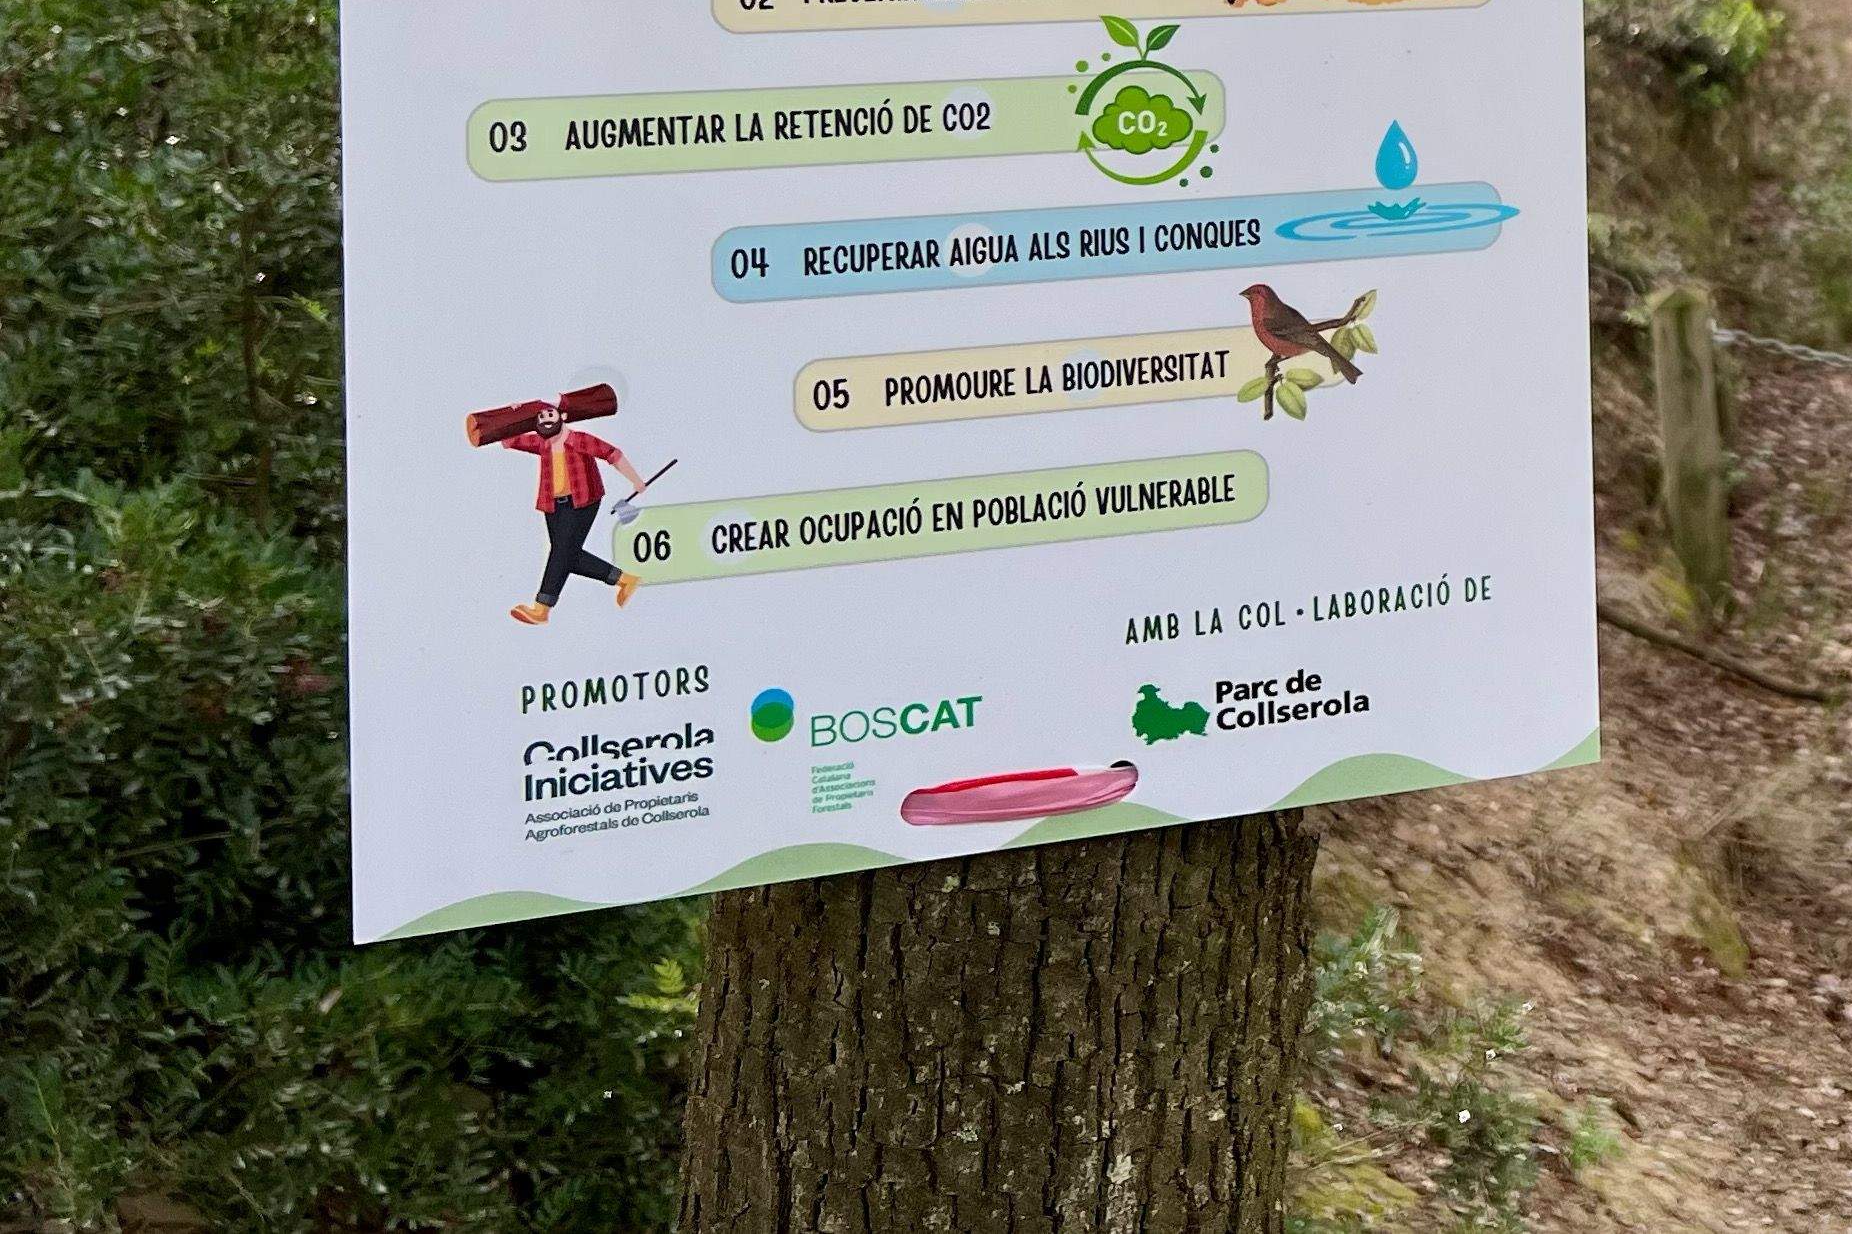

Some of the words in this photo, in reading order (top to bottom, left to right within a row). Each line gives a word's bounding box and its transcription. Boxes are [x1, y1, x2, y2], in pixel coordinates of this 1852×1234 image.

[488, 120, 528, 153] 03
[564, 113, 726, 151] AUGMENTAR
[735, 111, 764, 143] LA
[773, 98, 894, 142] RETENCIÓ
[903, 105, 933, 136] DE
[942, 102, 991, 133] CO2
[730, 246, 770, 279] 04
[803, 239, 942, 277] RECUPERAR
[948, 234, 1019, 268] AIGUA
[1028, 231, 1071, 262] ALS
[1079, 228, 1130, 258] RIUS
[1138, 226, 1146, 255] I
[1154, 217, 1262, 253] CONQUES
[813, 378, 850, 411] 05
[884, 368, 1017, 407] PROMOURE
[1025, 364, 1053, 396] LA
[1061, 349, 1230, 393] BIODIVERSITAT
[632, 530, 672, 564] 06
[710, 519, 790, 556] CREAR
[798, 497, 923, 548] OCUPACIÓ
[931, 502, 964, 533] EN
[972, 480, 1087, 529] POBLACIÓ
[1095, 473, 1237, 516] VULNERABLE
[1124, 612, 1180, 645] AMB
[1194, 607, 1224, 636] LA
[1464, 574, 1492, 603] DE
[521, 664, 711, 714] PROMOTORS
[1215, 674, 1279, 704] Parc
[1286, 668, 1322, 695] de
[1216, 689, 1370, 731] Collserola
[810, 695, 984, 748] BOSCAT
[524, 756, 714, 802] Iniciatives
[524, 802, 602, 825] Associació
[603, 802, 623, 815] de
[624, 790, 700, 812] Propietaris
[524, 816, 620, 843] Agroforestals
[621, 816, 640, 828] de
[641, 805, 710, 826] Collserola
